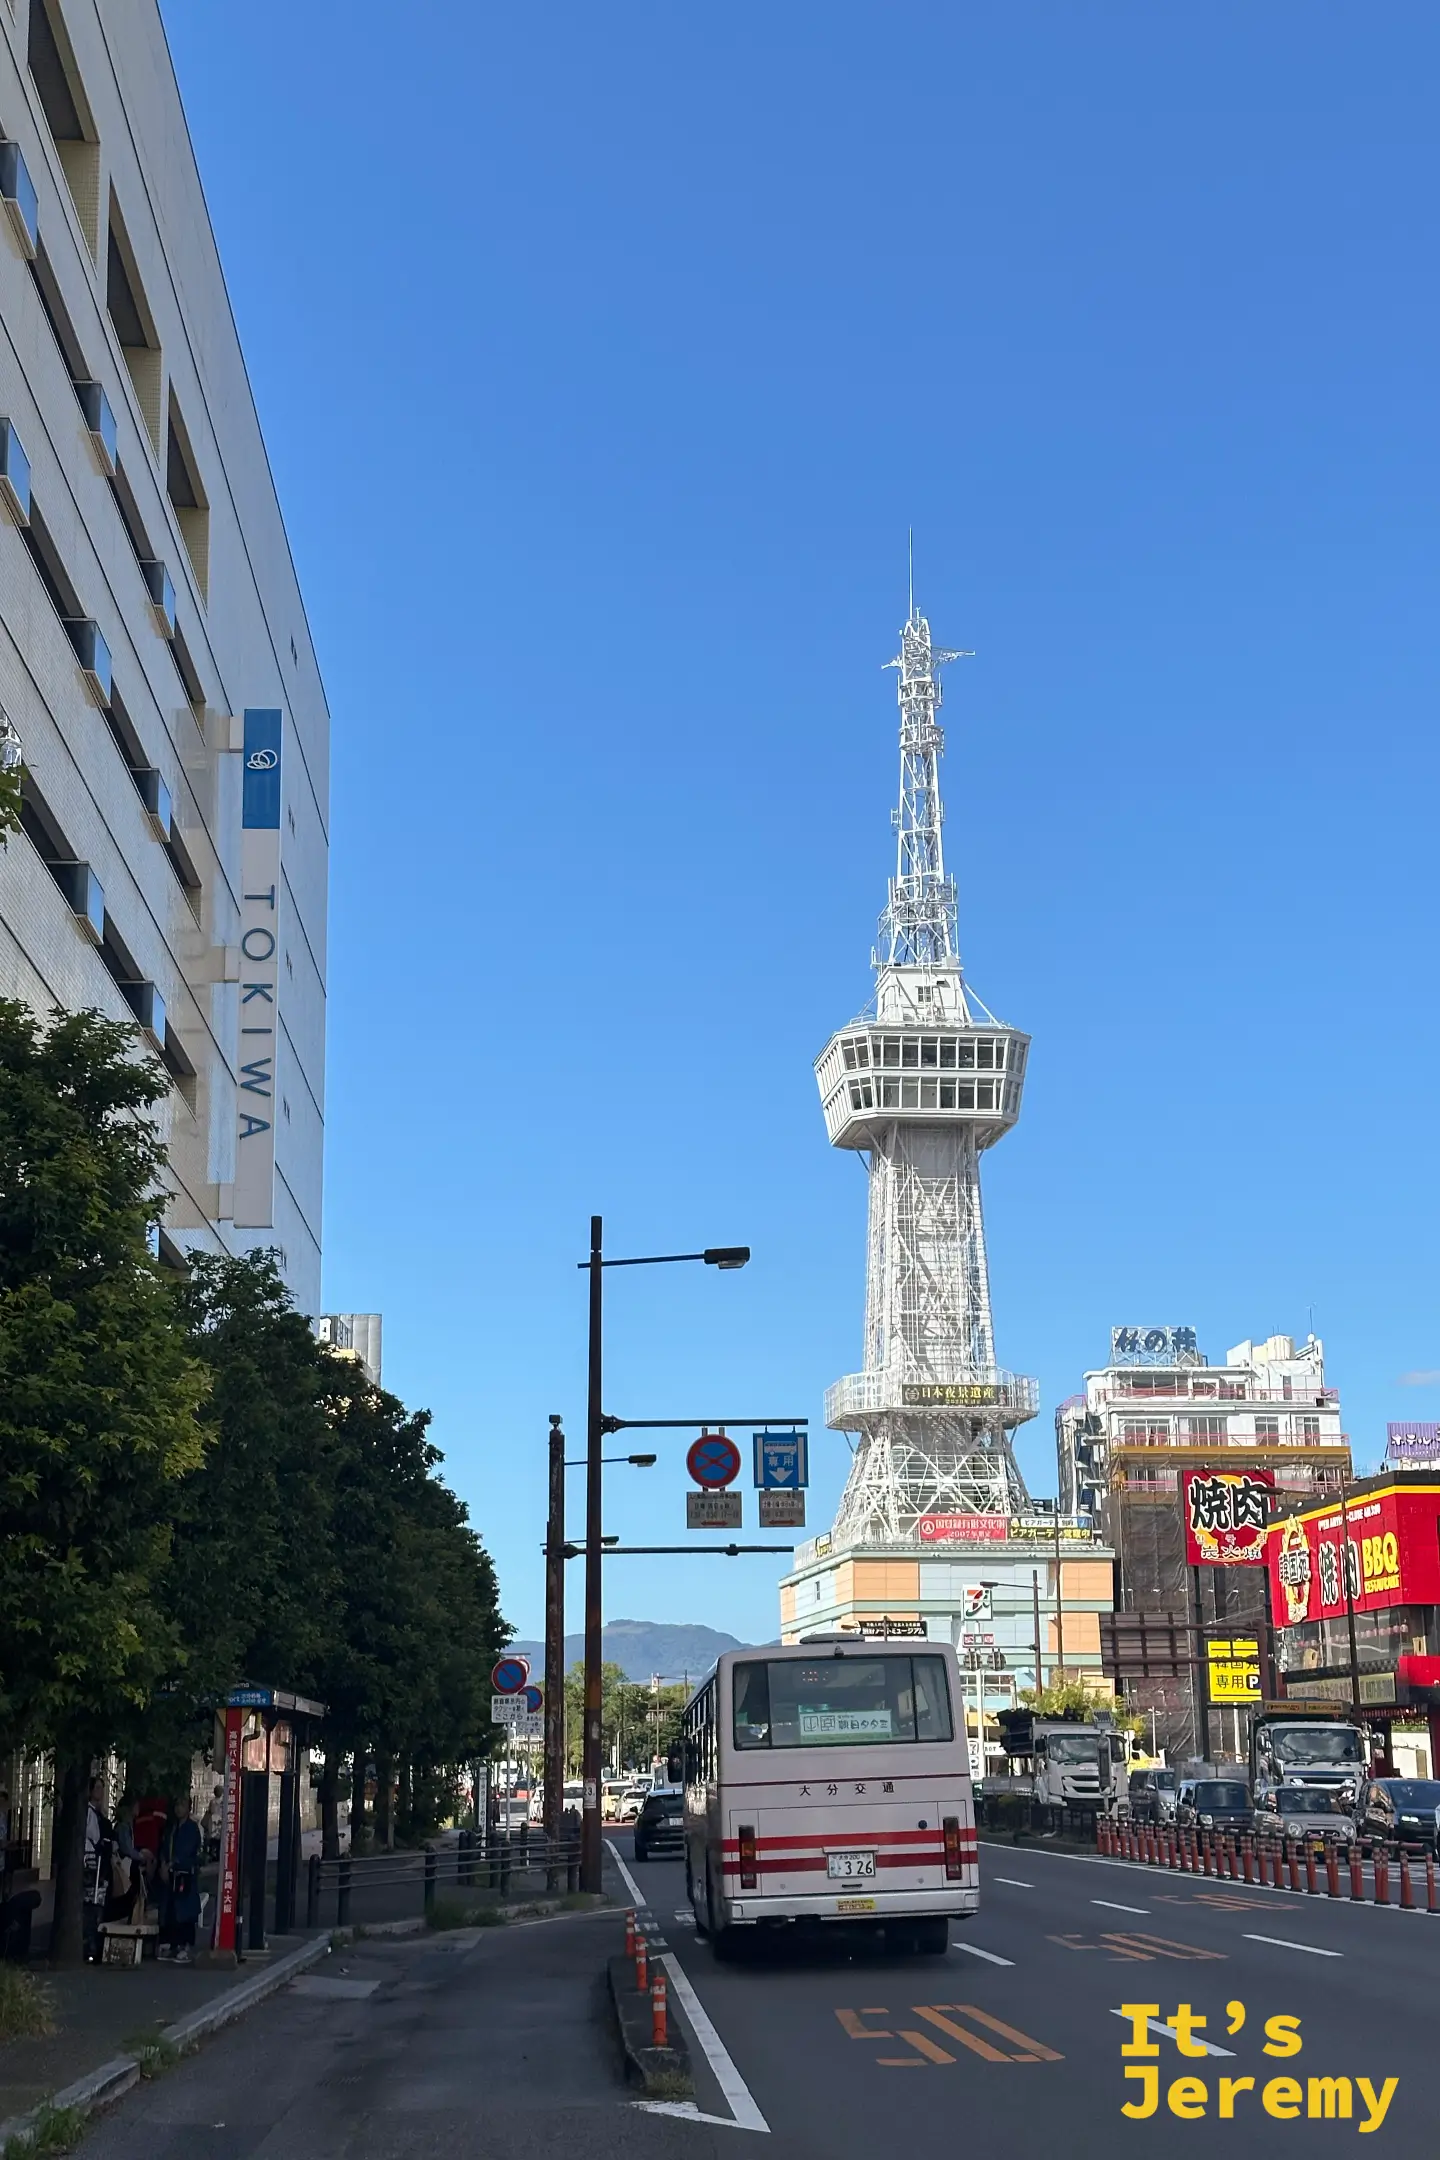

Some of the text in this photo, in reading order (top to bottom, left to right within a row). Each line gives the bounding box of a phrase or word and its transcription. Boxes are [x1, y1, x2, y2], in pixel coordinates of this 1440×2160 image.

[240, 884, 275, 1140] TOKIWA
[1188, 1477, 1269, 1530] 焼肉
[1362, 1531, 1399, 1579] BBQ
[800, 1781, 895, 1796] 大分交通
[1045, 1932, 1229, 1961] 50
[834, 2003, 1066, 2066] 50
